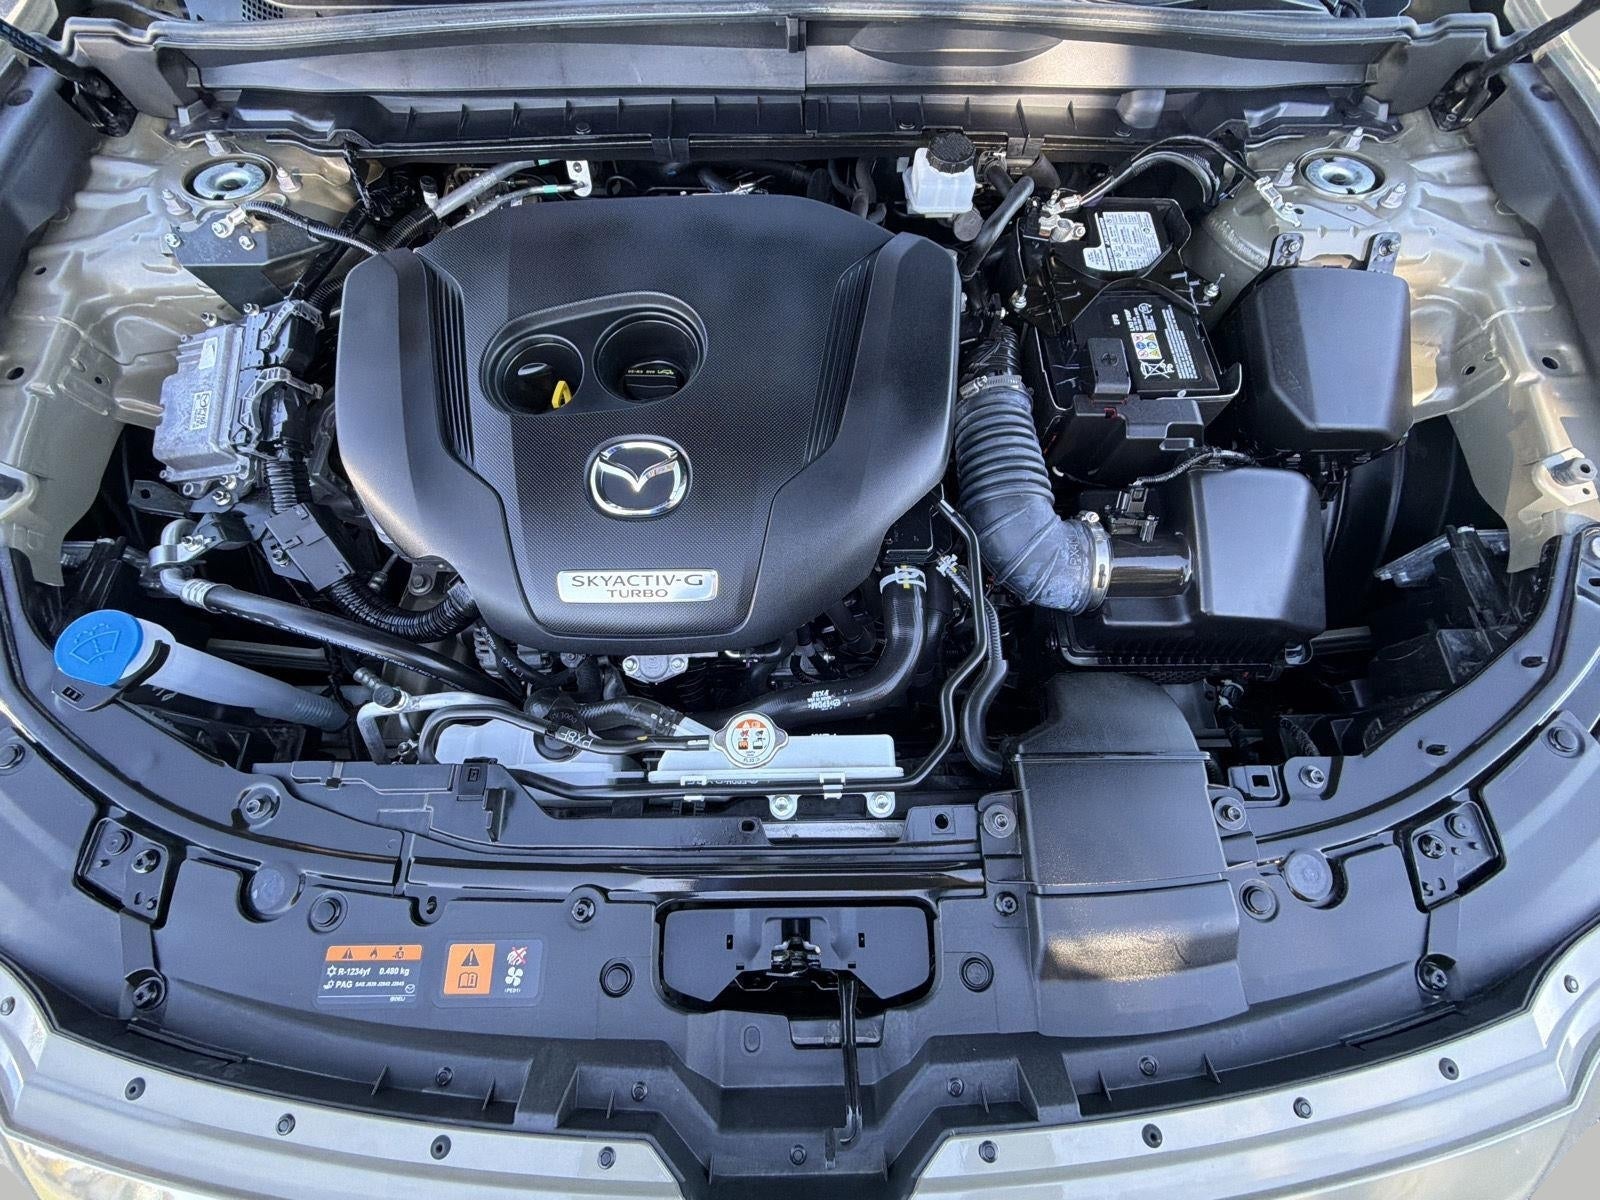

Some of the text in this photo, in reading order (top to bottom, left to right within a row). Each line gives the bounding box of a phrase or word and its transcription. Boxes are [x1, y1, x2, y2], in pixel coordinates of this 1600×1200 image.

[571, 574, 703, 587] SKYACTIV-G
[606, 589, 668, 598] TURBO
[560, 730, 594, 749] PX8F
[337, 967, 371, 977] R-1234yf
[399, 967, 410, 977] kg
[335, 981, 353, 989] PAG
